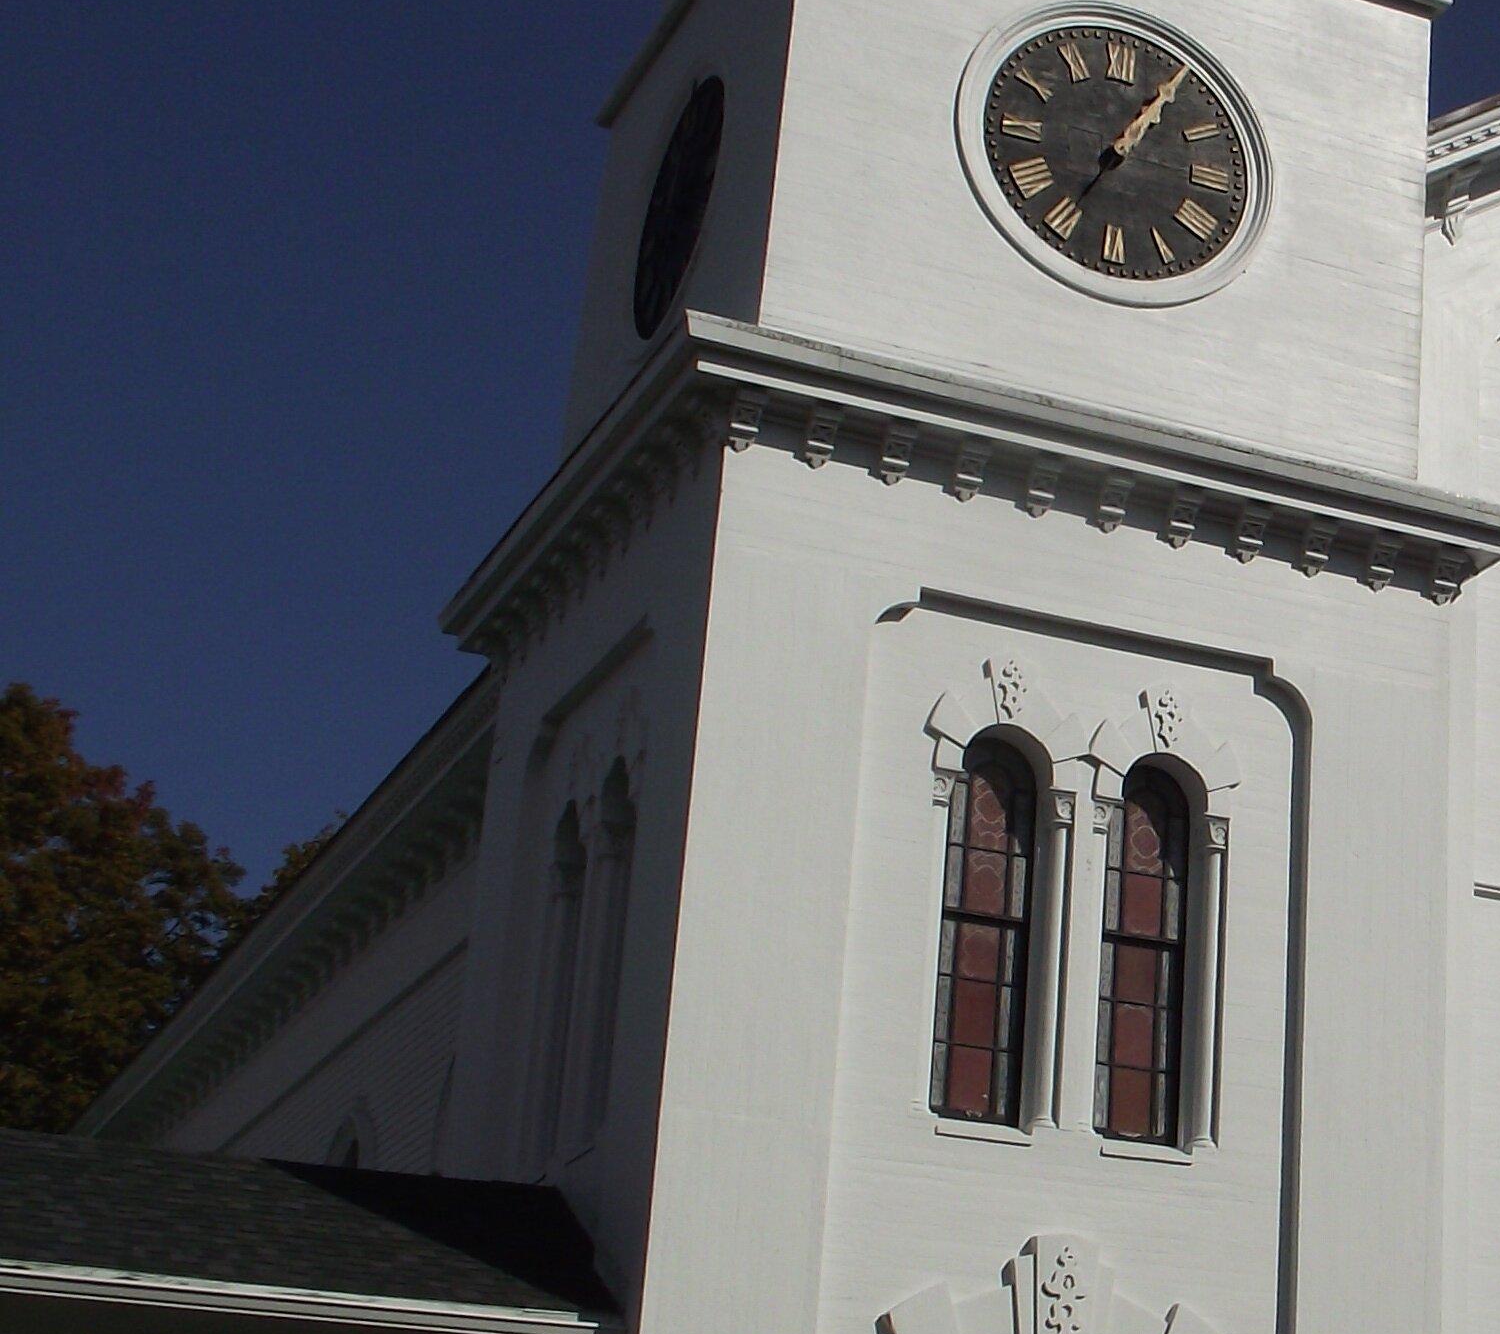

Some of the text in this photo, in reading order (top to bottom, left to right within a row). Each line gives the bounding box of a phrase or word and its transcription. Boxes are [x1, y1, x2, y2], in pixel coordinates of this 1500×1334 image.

[1057, 43, 1090, 82] XI
[1106, 42, 1136, 85] XII
[1014, 67, 1054, 103] X
[1001, 112, 1043, 142] IX
[1183, 123, 1220, 141] II
[1008, 156, 1054, 199] VIII
[1190, 164, 1229, 193] III
[1043, 196, 1083, 240] VII
[1103, 224, 1126, 265] VI
[1151, 227, 1175, 264] V
